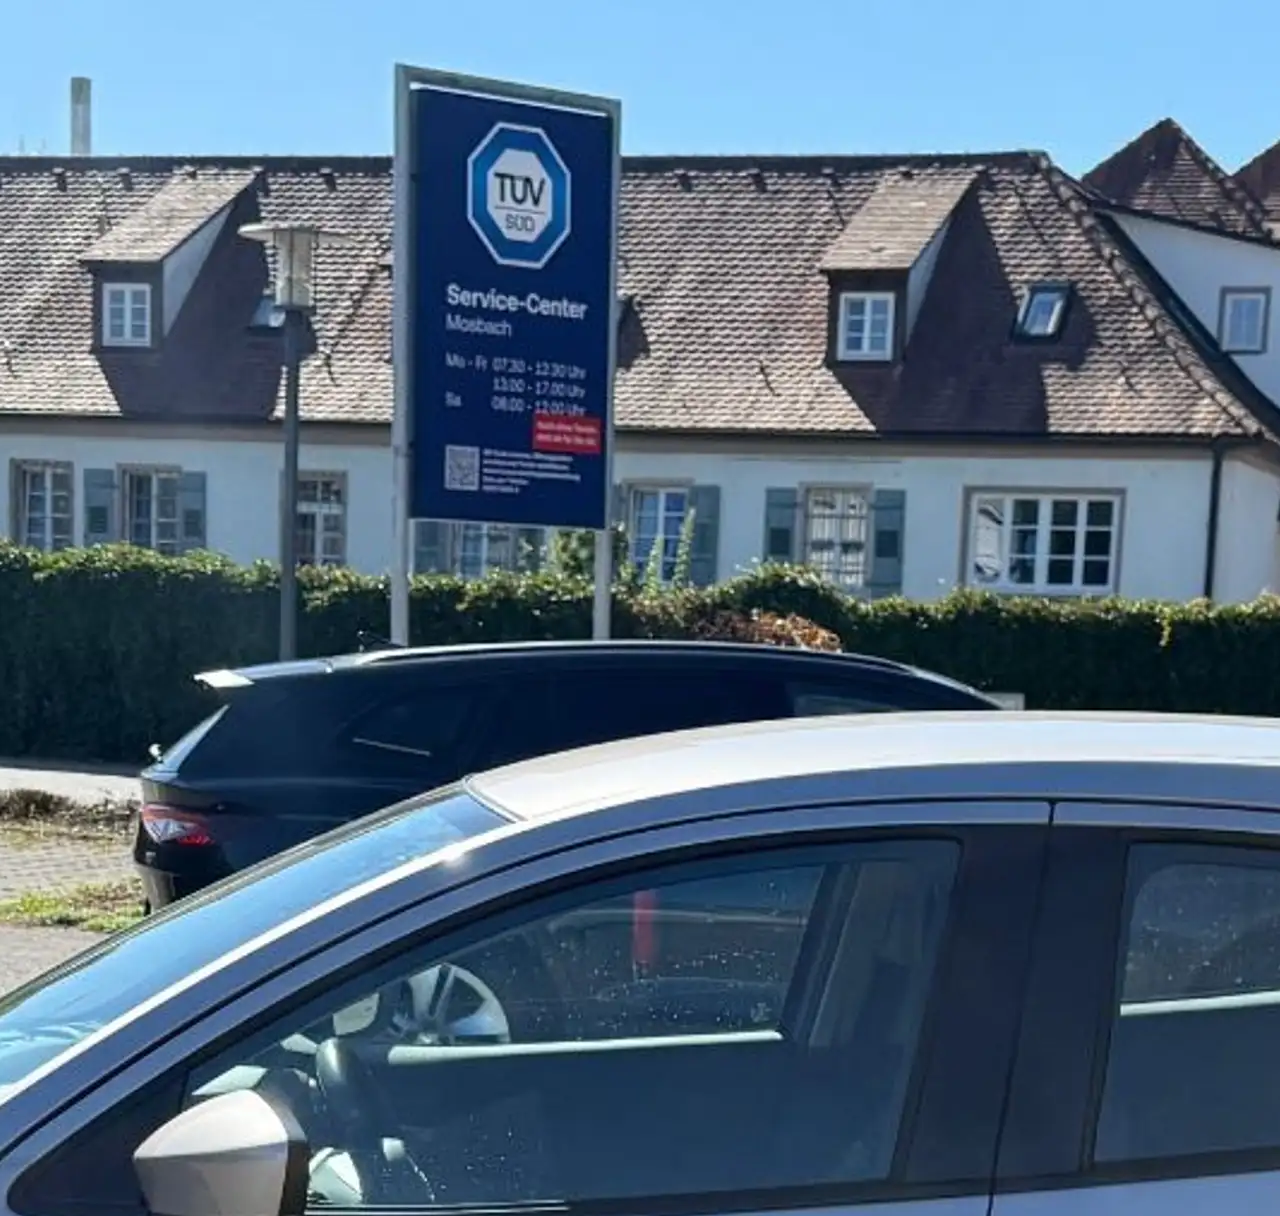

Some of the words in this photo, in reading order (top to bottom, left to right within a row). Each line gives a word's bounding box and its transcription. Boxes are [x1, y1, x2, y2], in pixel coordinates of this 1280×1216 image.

[493, 172, 546, 207] TÜV
[447, 282, 589, 320] Service-Center
[445, 313, 513, 337] Mosbach
